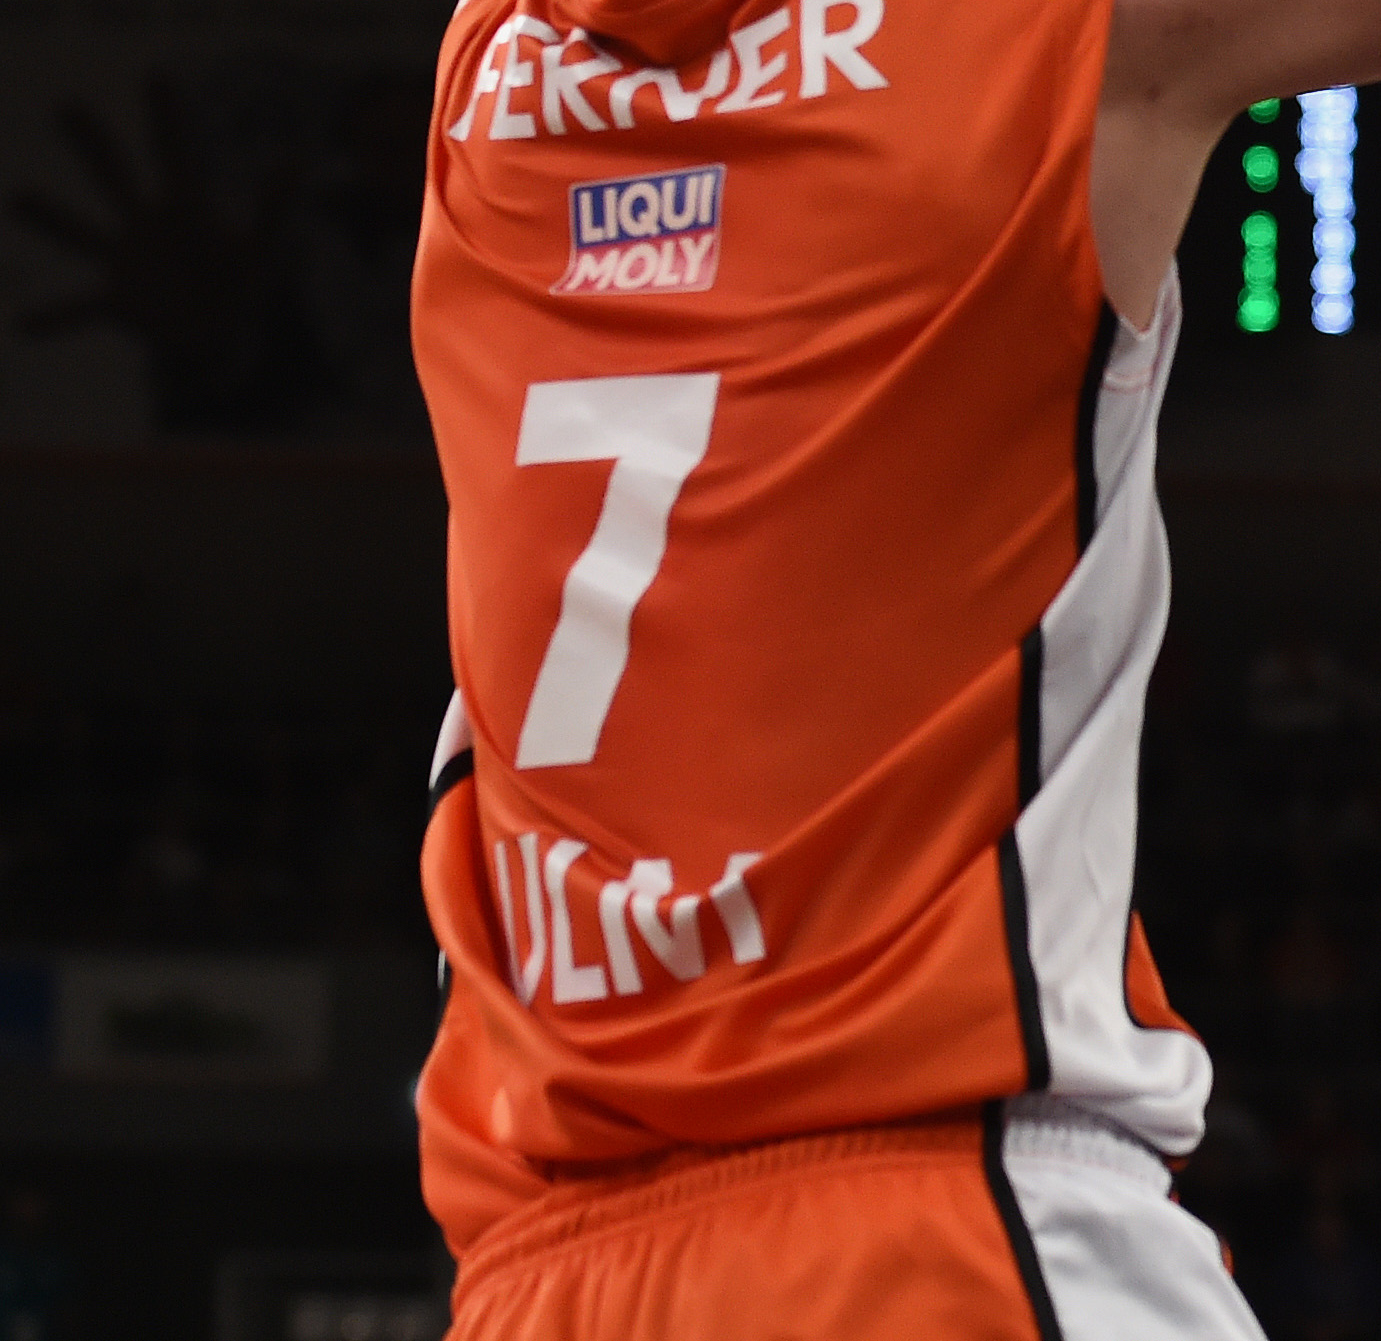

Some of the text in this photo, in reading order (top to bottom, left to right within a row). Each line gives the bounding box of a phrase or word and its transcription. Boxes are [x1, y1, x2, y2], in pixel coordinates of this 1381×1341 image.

[566, 232, 714, 292] MOLY
[578, 171, 717, 245] LIQUI
[513, 371, 720, 769] 7
[494, 831, 768, 1009] ULM
